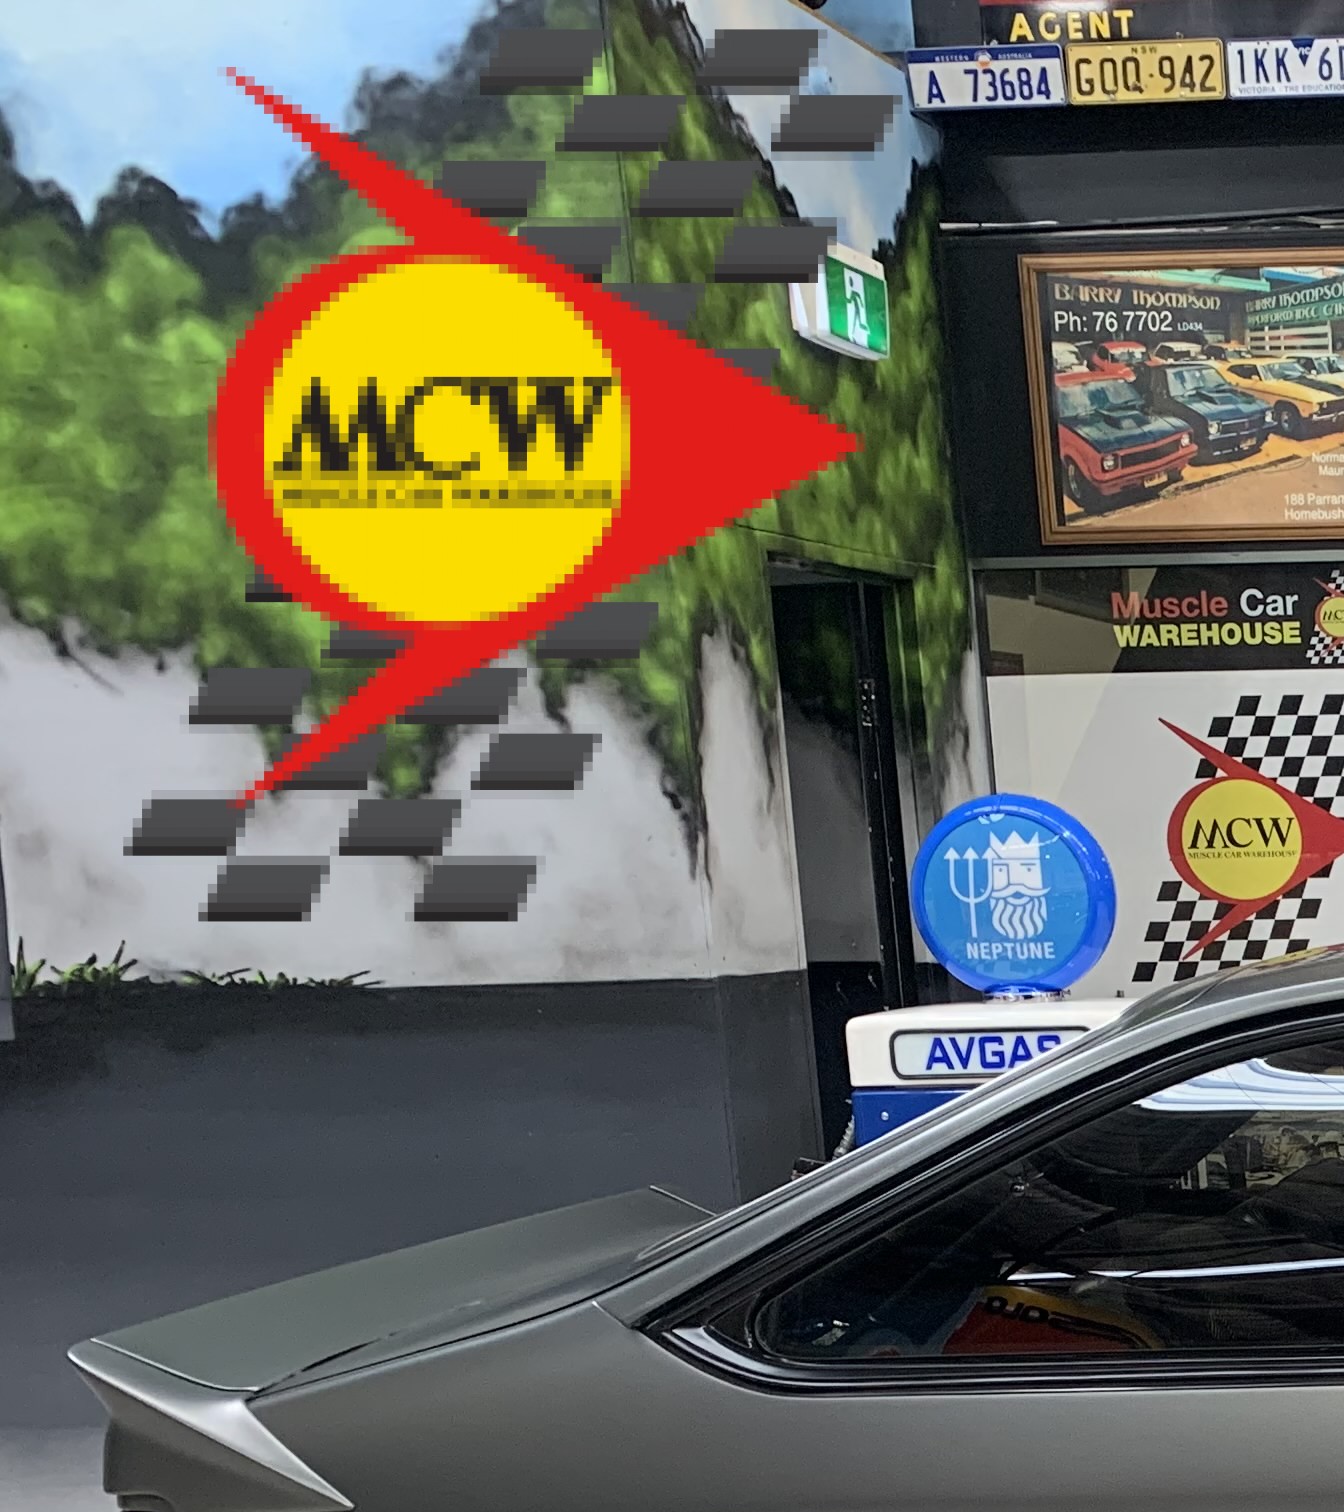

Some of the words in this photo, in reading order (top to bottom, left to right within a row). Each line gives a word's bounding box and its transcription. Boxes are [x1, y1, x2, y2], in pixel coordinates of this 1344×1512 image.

[1009, 10, 1134, 42] AGENT
[927, 70, 945, 104] A
[964, 67, 1051, 103] 73684
[1238, 86, 1276, 95] VICTORIA
[1054, 283, 1121, 305] BARRY
[1054, 311, 1088, 332] Ph:
[1092, 310, 1119, 332] 76
[1123, 310, 1173, 332] 7702
[1285, 507, 1344, 520] Homebush
[1111, 590, 1229, 619] Muscle
[1240, 588, 1299, 617] Car
[1113, 621, 1302, 648] WAREHOUSE
[1187, 817, 1295, 849] MCW
[1224, 851, 1242, 859] CAR
[966, 942, 1056, 960] NEPTUNE
